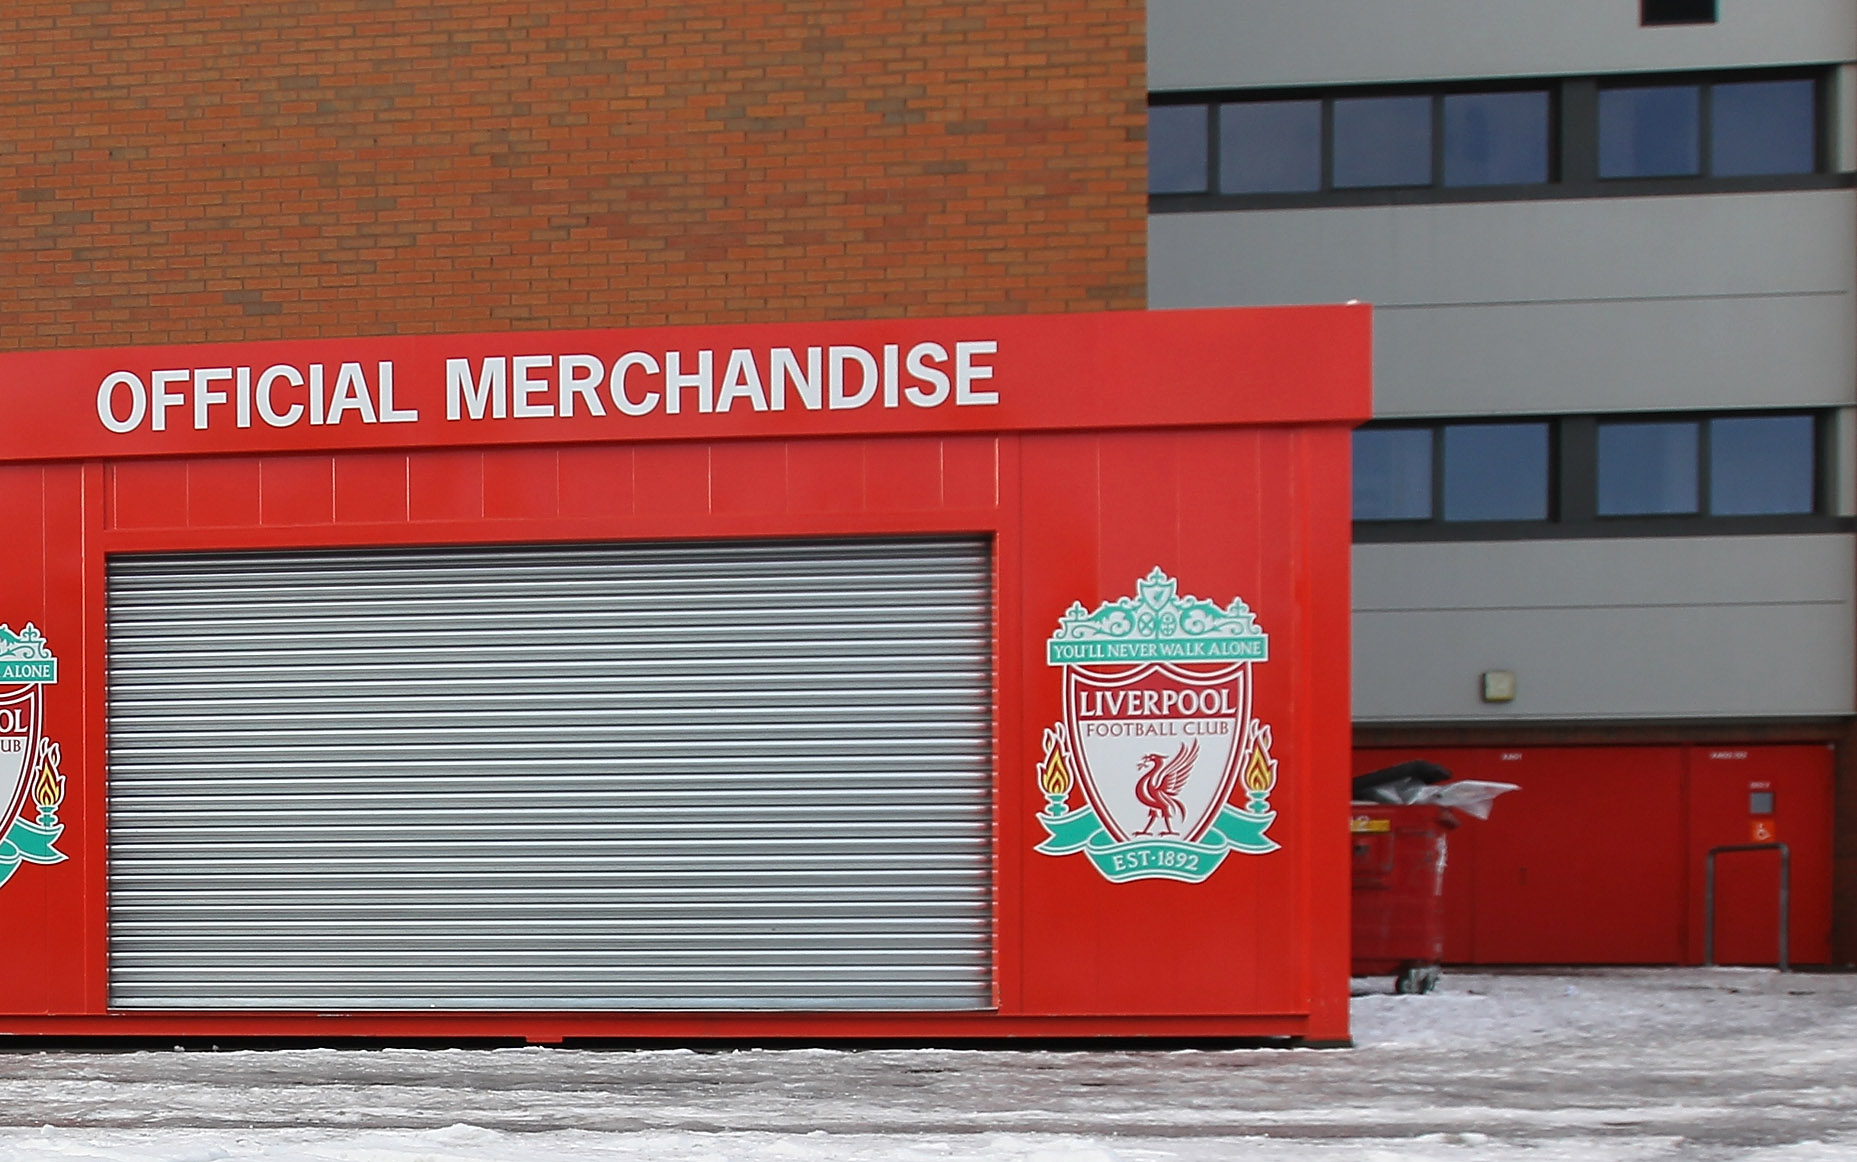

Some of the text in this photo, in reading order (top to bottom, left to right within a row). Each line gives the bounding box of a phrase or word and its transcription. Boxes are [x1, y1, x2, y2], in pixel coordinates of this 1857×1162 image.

[96, 340, 1001, 434] OFFICIAL MERCHANDISE
[1054, 641, 1262, 659] YOU'LL NEVER WALK ALONE
[3, 664, 51, 678] ALONE
[1080, 688, 1237, 716] LIVERPOOL
[1086, 721, 1230, 737] FOOTBALL CLUB
